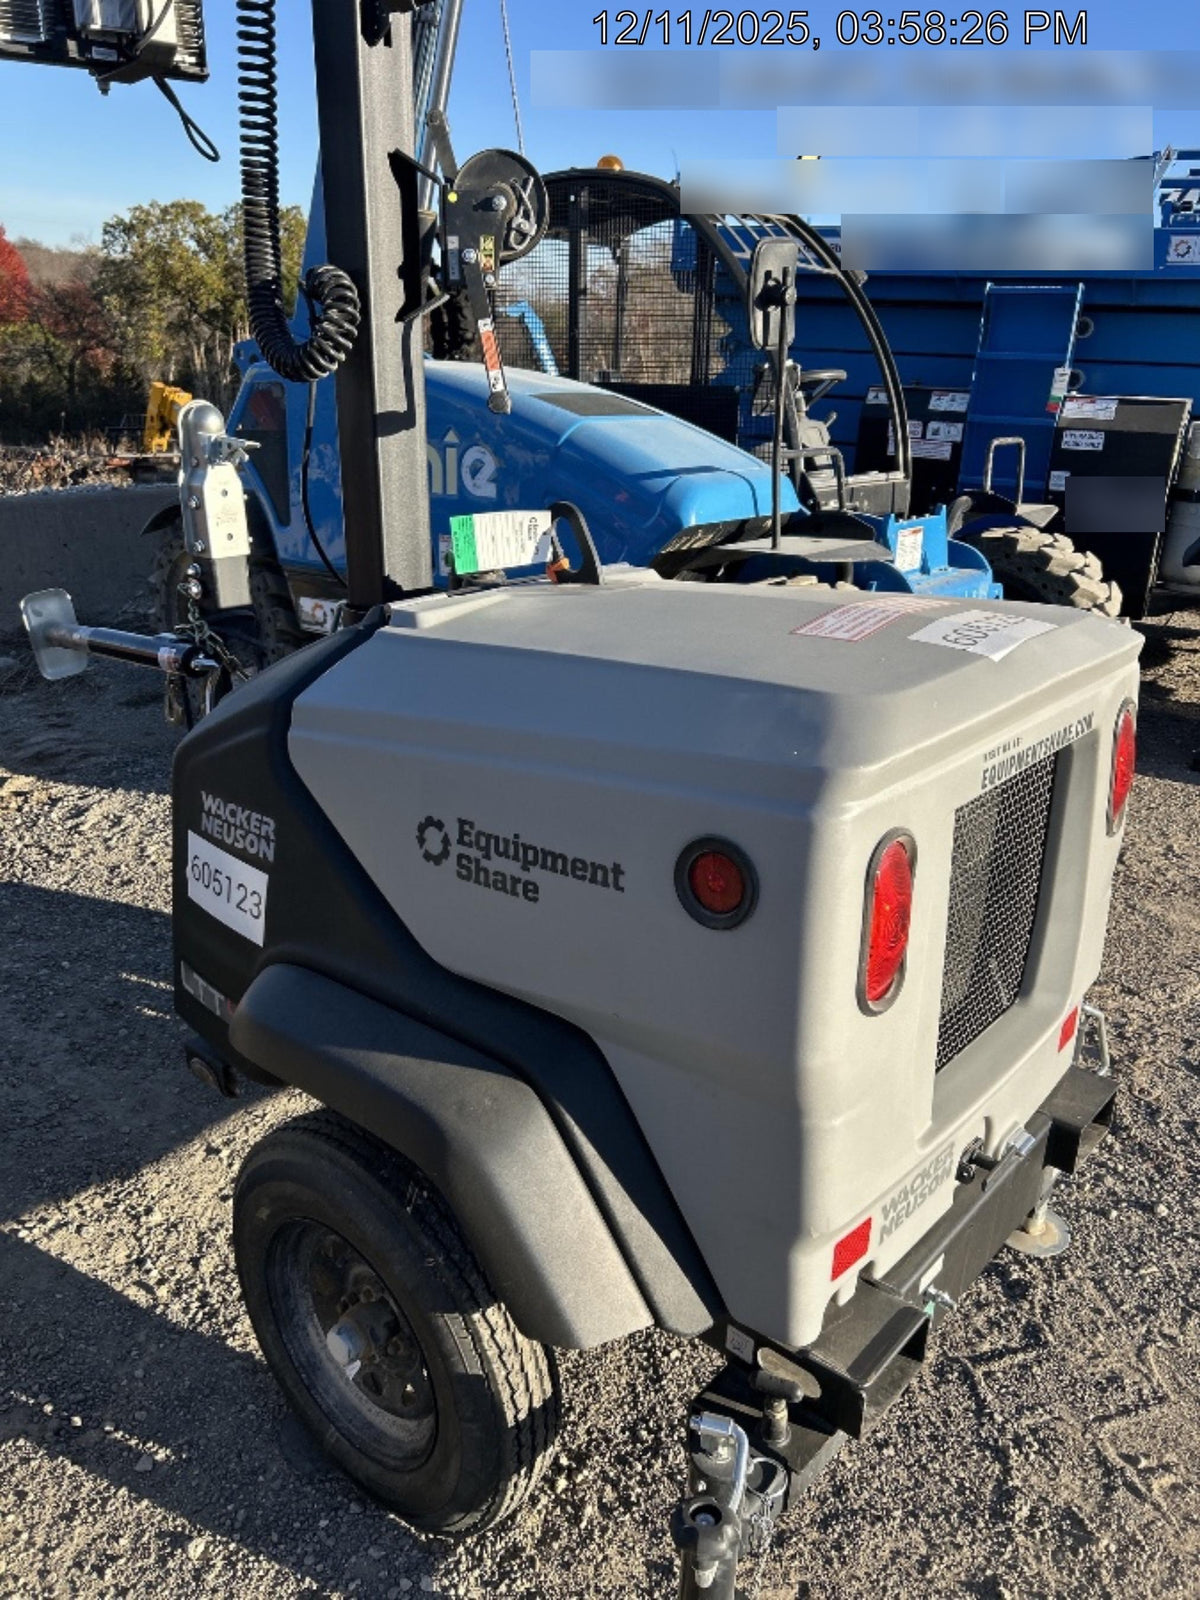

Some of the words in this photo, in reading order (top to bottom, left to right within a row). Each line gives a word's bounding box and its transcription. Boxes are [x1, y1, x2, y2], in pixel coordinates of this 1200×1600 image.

[201, 790, 276, 840] WACKER
[201, 812, 276, 863] NEUSON
[191, 854, 262, 920] 605123
[456, 817, 625, 893] Equipment
[456, 852, 540, 903] Share
[878, 1159, 954, 1247] NEUSON
[881, 1141, 956, 1221] WACKER
